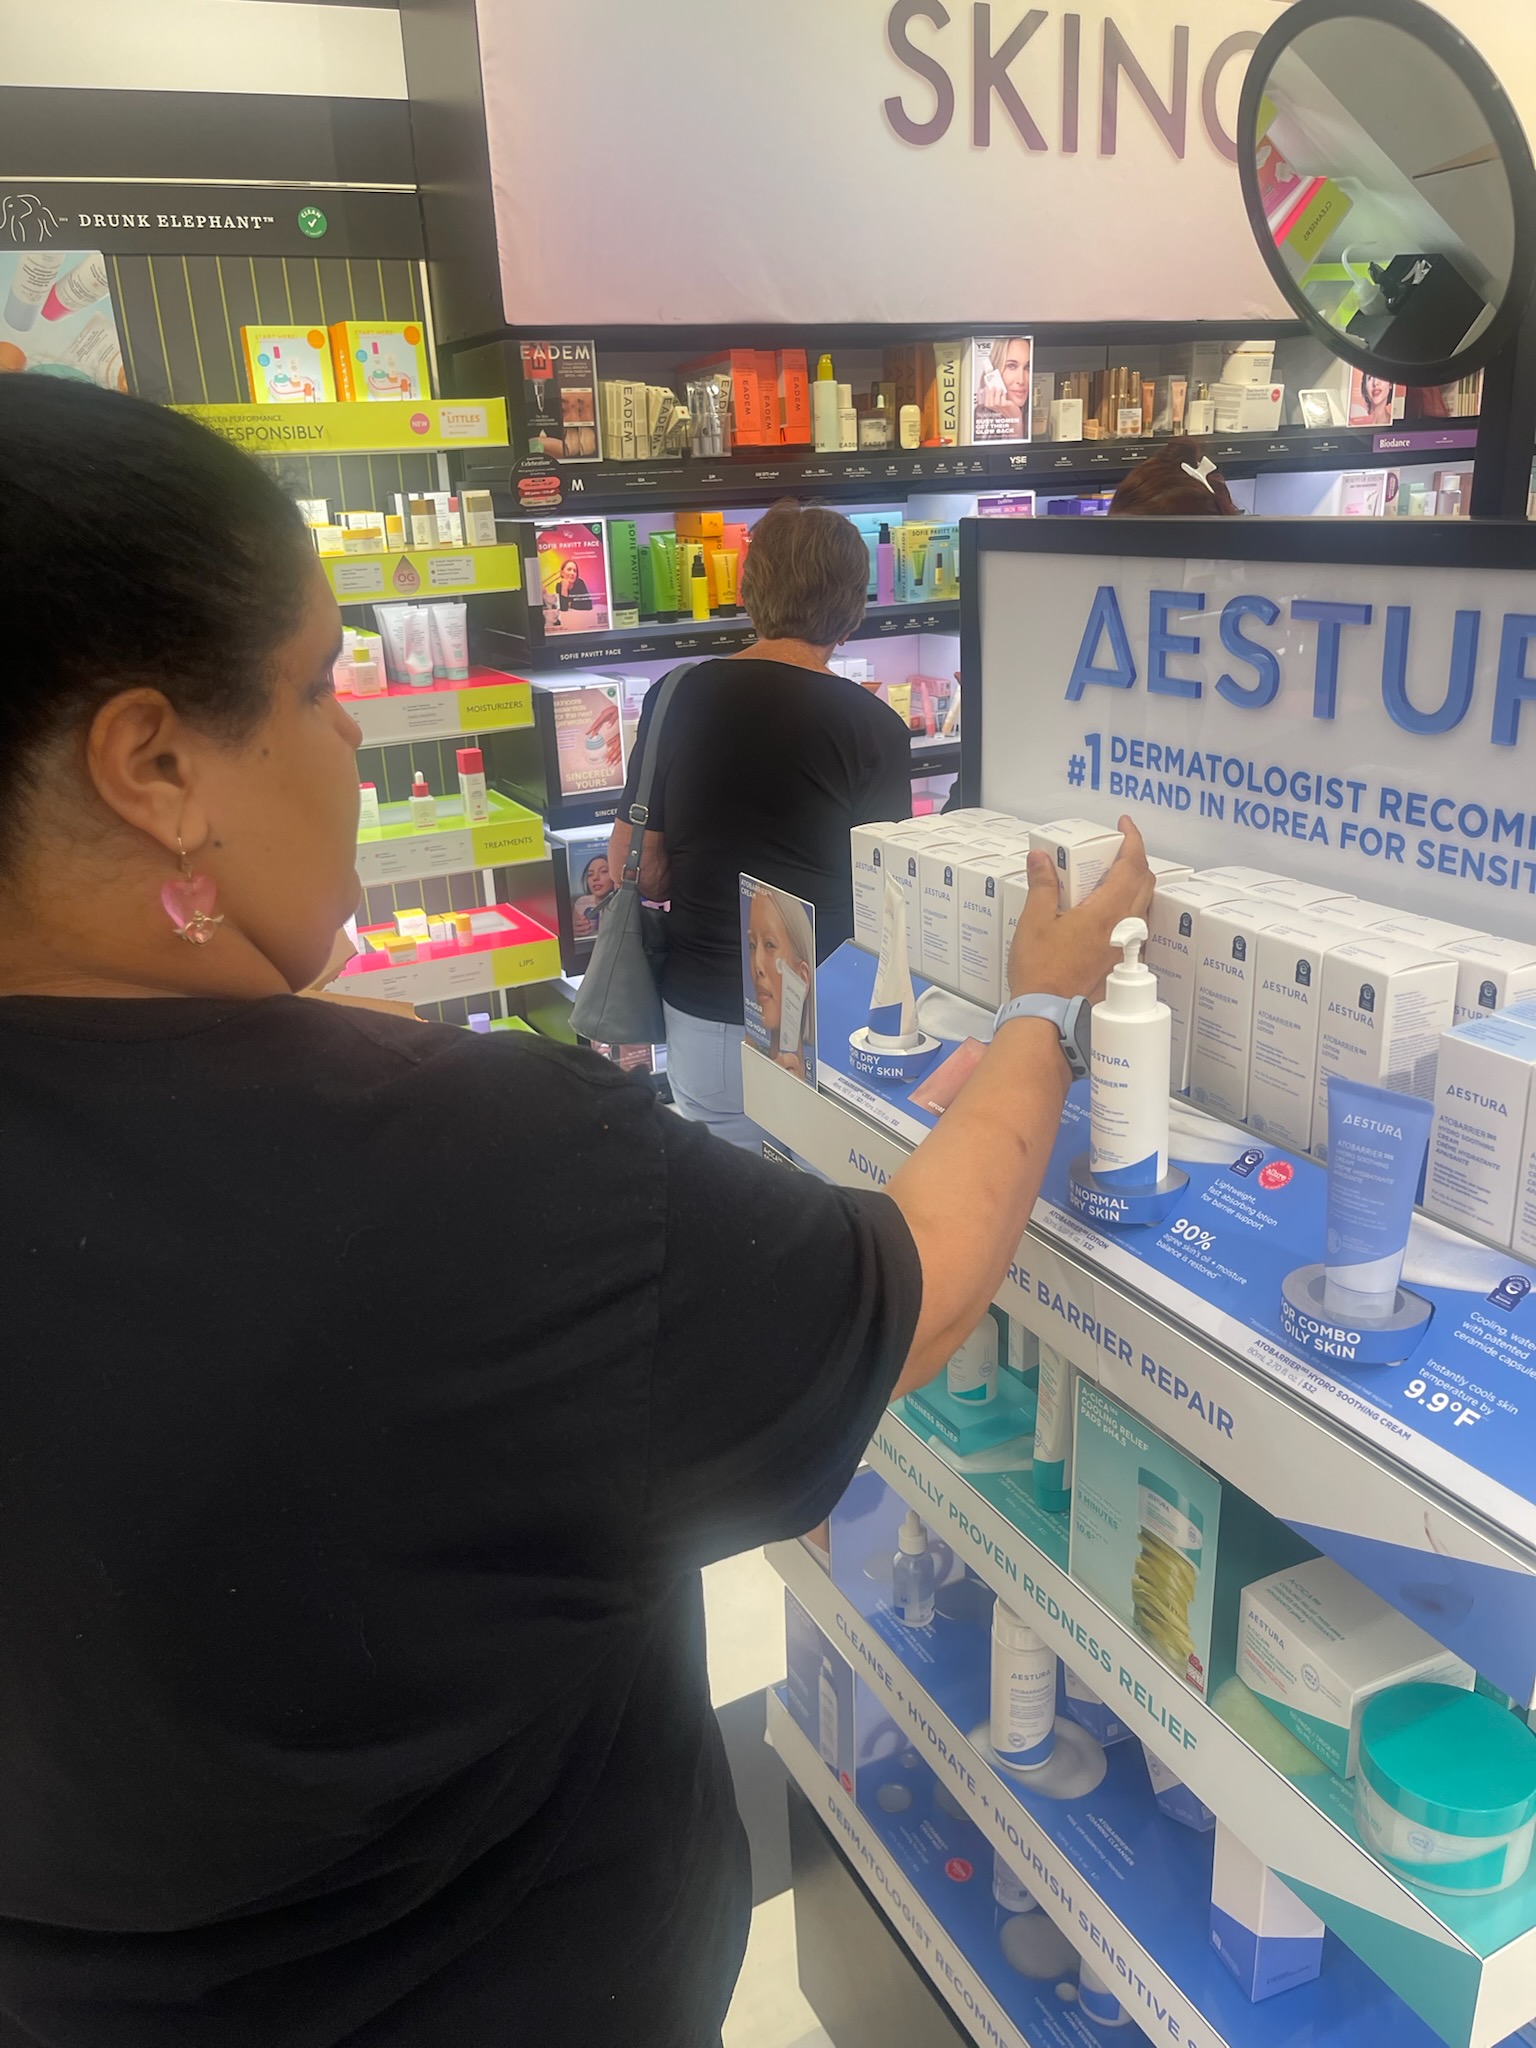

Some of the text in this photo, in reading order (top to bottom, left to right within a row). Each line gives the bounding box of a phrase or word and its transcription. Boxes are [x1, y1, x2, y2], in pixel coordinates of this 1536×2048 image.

[78, 214, 152, 229] DRUNK
[520, 345, 590, 360] EADEM
[742, 380, 751, 416] EADEM
[793, 376, 801, 412] EADEM
[943, 361, 956, 431] EADEM
[447, 415, 481, 424] LITTLES
[623, 386, 633, 443] EADEM
[763, 395, 772, 431] EADEM
[1380, 438, 1411, 448] Biodance
[1010, 456, 1027, 464] YSE
[559, 541, 582, 549] PAVITT
[583, 540, 600, 548] FACE
[628, 523, 637, 553] SOFIE
[397, 572, 415, 583] OG
[560, 648, 622, 661] SOFIE PAVITT FACE
[466, 701, 523, 713] MOISTURIZERS
[565, 768, 616, 782] SINCERELY
[1067, 733, 1101, 791] #1
[576, 778, 607, 789] YOURS
[1111, 735, 1536, 852] DERMATOLOGIST RECOM
[1110, 771, 1192, 811] BRAND
[1200, 791, 1224, 820] IN
[1233, 800, 1330, 846] KOREA
[1340, 823, 1406, 864] FOR
[484, 836, 533, 849] TREATMENTS
[855, 861, 878, 874] AESTURA
[924, 886, 951, 902] AESTURA
[963, 900, 992, 918] AESTURA
[1151, 933, 1189, 956] AESTURA
[518, 958, 534, 968] LIPS
[1202, 957, 1245, 981] AESTURA
[1261, 979, 1309, 1005] AESTURA
[1328, 1001, 1375, 1030] AESTURA
[856, 1061, 904, 1077] DRY SKIN
[860, 1052, 880, 1065] DRY
[927, 1100, 946, 1114] BEFORE
[1446, 1084, 1508, 1118] AESTURA
[1342, 1113, 1403, 1141] AESTURA
[1437, 1124, 1460, 1139] HYDRO
[1437, 1132, 1459, 1146] CREAM
[848, 1147, 892, 1186] ADVA
[1265, 1167, 1287, 1182] allure
[1075, 1185, 1129, 1210] NORMAL
[1207, 1185, 1278, 1227] fast absorbing lotion
[1088, 1205, 1120, 1221] SKIN
[1200, 1193, 1264, 1231] for barrier support
[1082, 1241, 1095, 1251] $32
[1086, 1232, 1110, 1250] LOTION
[1170, 1217, 1217, 1251] 90%
[1155, 1239, 1182, 1260] balance
[1181, 1253, 1189, 1263] is
[1162, 1232, 1248, 1285] agree skin's oil moisture
[1281, 1297, 1361, 1345] OR COMBO
[1469, 1311, 1509, 1338] Cooling,
[1008, 1262, 1234, 1440] RE BARRIER REPAIR
[1284, 1320, 1356, 1360] OILY SKIN
[1453, 1329, 1499, 1358] ceramide
[1462, 1320, 1531, 1361] with patented
[1246, 1346, 1266, 1363] 80mL
[1265, 1358, 1283, 1372] 2.70
[1301, 1381, 1318, 1395] $32
[1418, 1367, 1495, 1417] temperature by
[1426, 1358, 1519, 1416] Instantly cools skin
[1307, 1371, 1412, 1442] HYDRO SOOTHING CREAM
[1403, 1378, 1482, 1428] 9.9°F
[934, 1419, 959, 1444] RELIEF
[1081, 1395, 1149, 1453] COOLING RELIEF
[1081, 1405, 1127, 1448] PADS pH4.5
[1083, 1494, 1120, 1531] MINUTES
[948, 1498, 1018, 1583] PROVEN
[1022, 1573, 1112, 1674] REDNESS
[1118, 1665, 1199, 1752] RELIEF
[1248, 1610, 1285, 1650] AESTURA
[1010, 1668, 1051, 1681] AESTURA
[835, 1612, 893, 1692] CLEANSE
[908, 1701, 977, 1797] HYDRATE
[980, 1793, 990, 1808] +
[994, 1809, 1074, 1913] NOURISH
[1078, 1910, 1181, 2042] SENSITIVE
[1107, 1837, 1135, 1866] CLEANSER
[828, 1795, 932, 1949] DERMATOLOGIST
